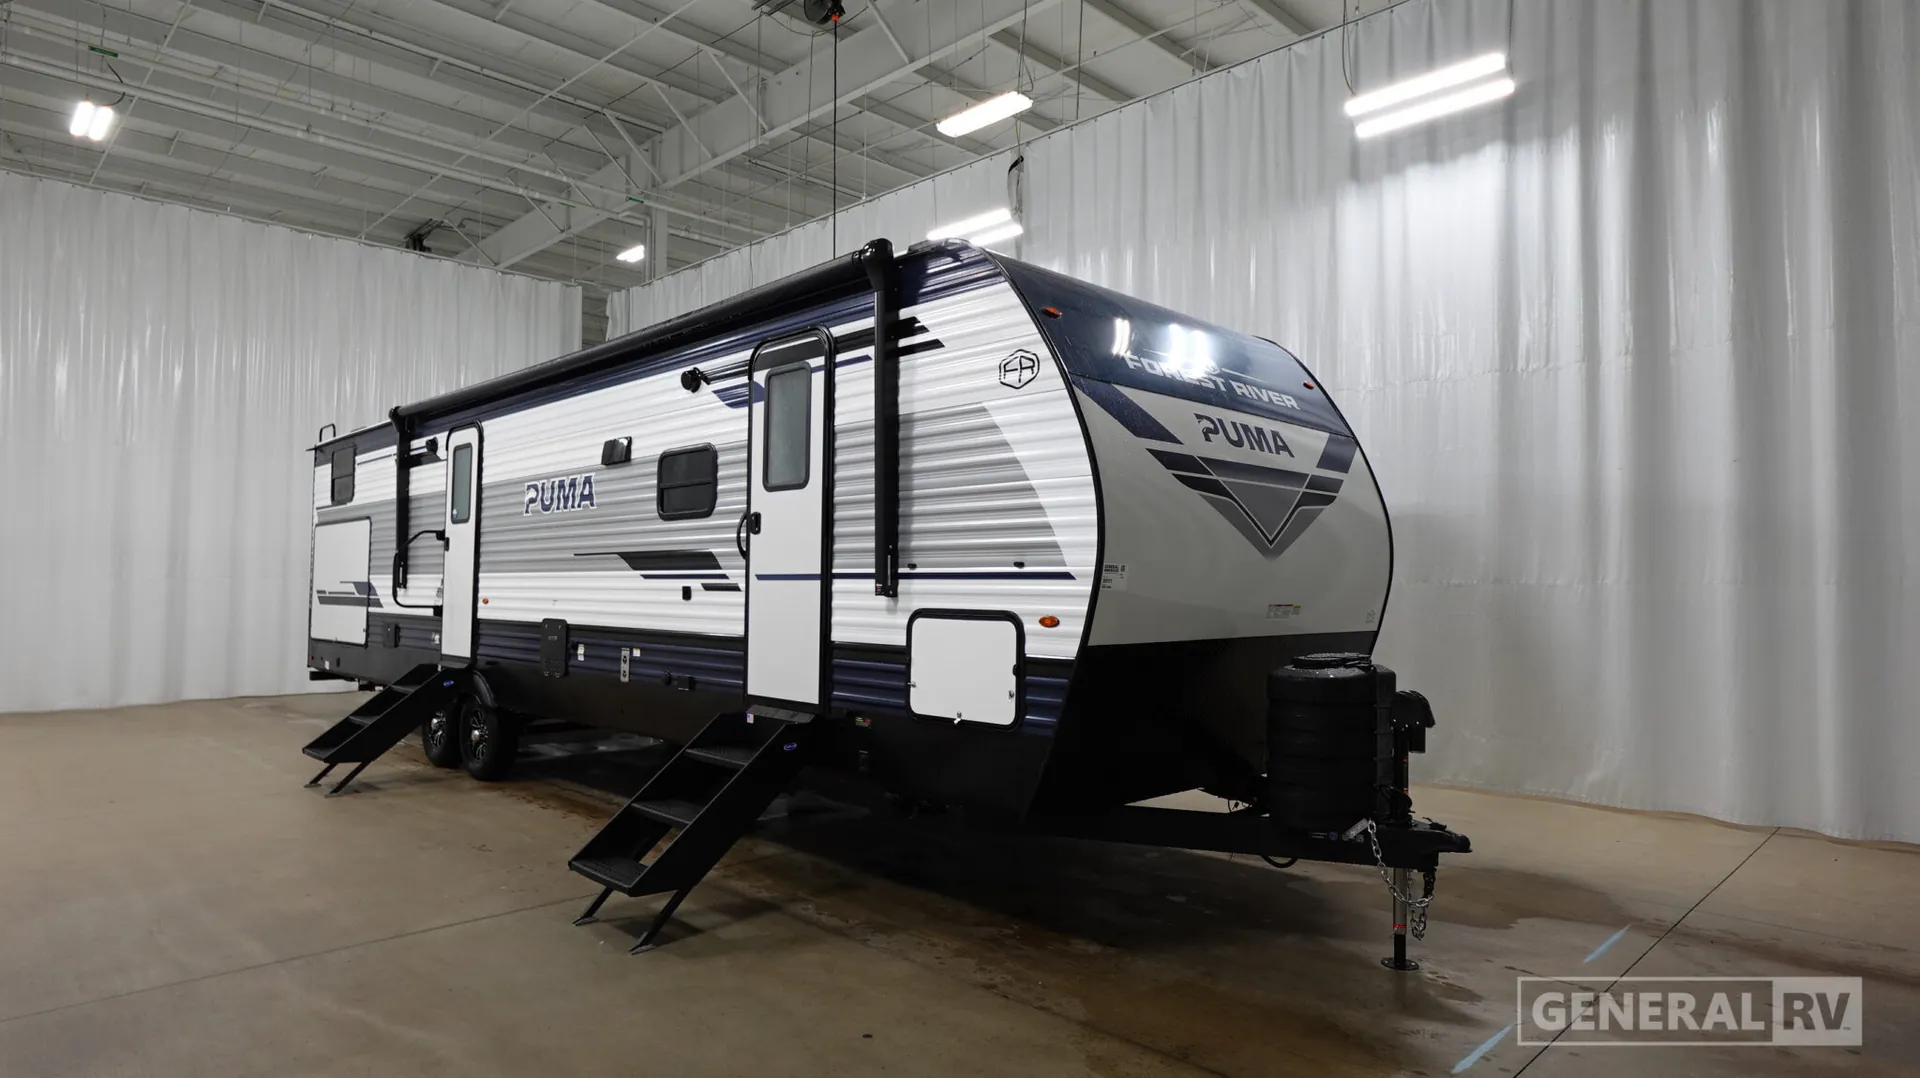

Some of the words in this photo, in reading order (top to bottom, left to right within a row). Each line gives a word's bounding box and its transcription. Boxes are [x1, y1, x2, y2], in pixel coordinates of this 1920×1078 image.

[1230, 380, 1300, 410] RIVER
[1194, 412, 1295, 458] PUMA
[523, 472, 597, 516] PUMA
